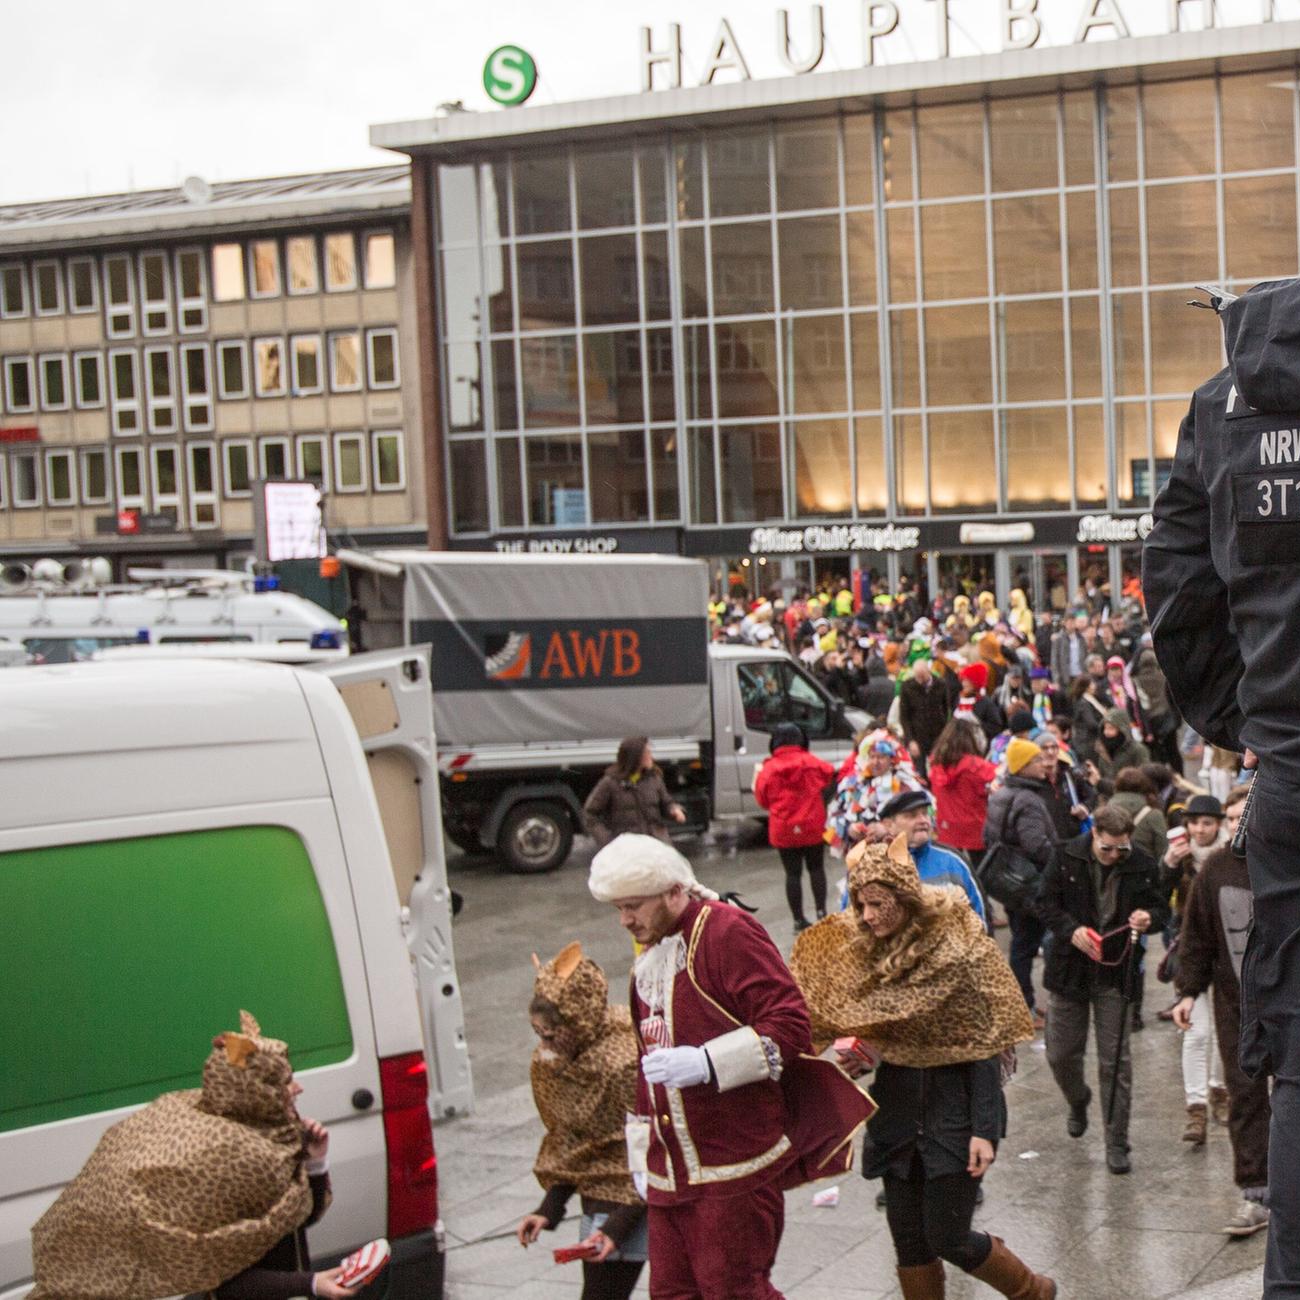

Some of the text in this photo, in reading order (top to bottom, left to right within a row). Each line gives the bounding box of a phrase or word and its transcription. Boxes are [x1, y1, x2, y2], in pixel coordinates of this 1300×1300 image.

[491, 49, 526, 101] S
[495, 536, 618, 553] THE BODY SHOP
[539, 628, 642, 680] AWB
